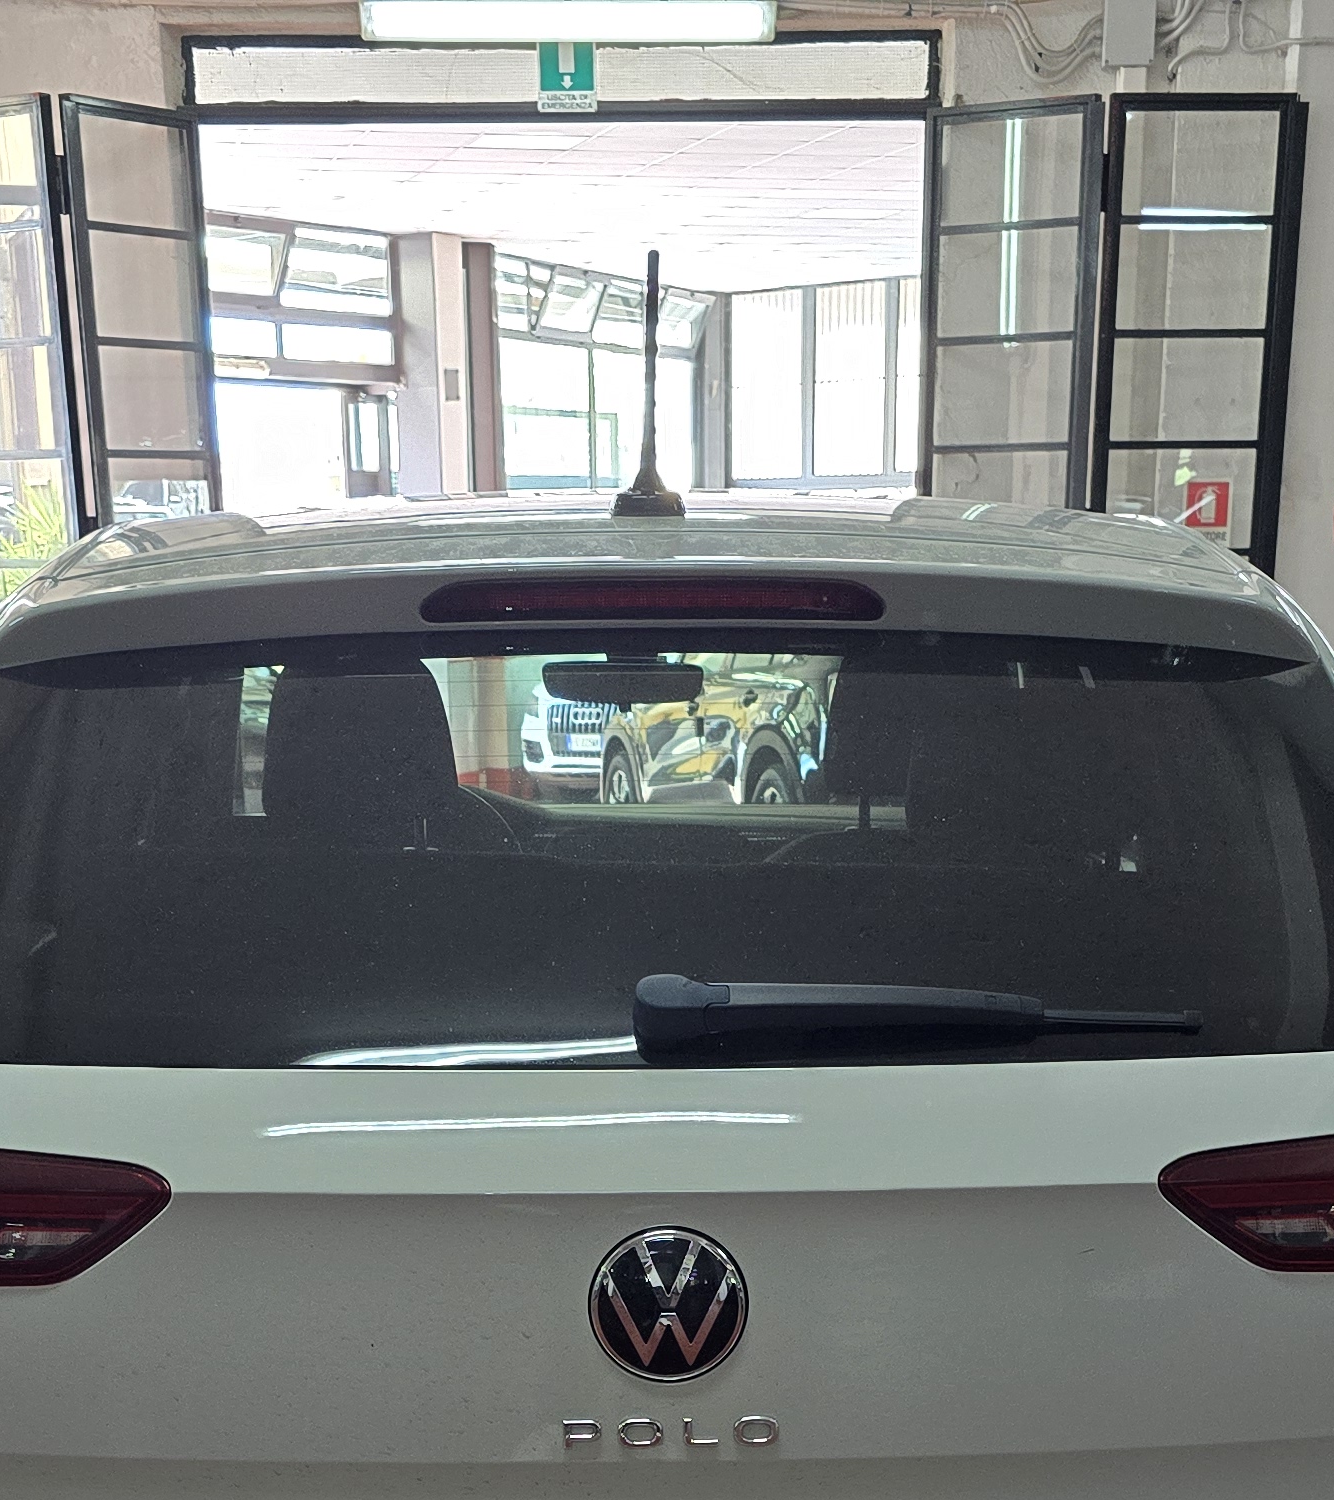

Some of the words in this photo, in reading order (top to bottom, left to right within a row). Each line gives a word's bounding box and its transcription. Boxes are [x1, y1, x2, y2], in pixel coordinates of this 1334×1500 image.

[546, 93, 577, 101] USCITA
[579, 93, 588, 101] DI
[541, 102, 593, 110] EMERGENZA
[562, 1415, 779, 1449] POLO
